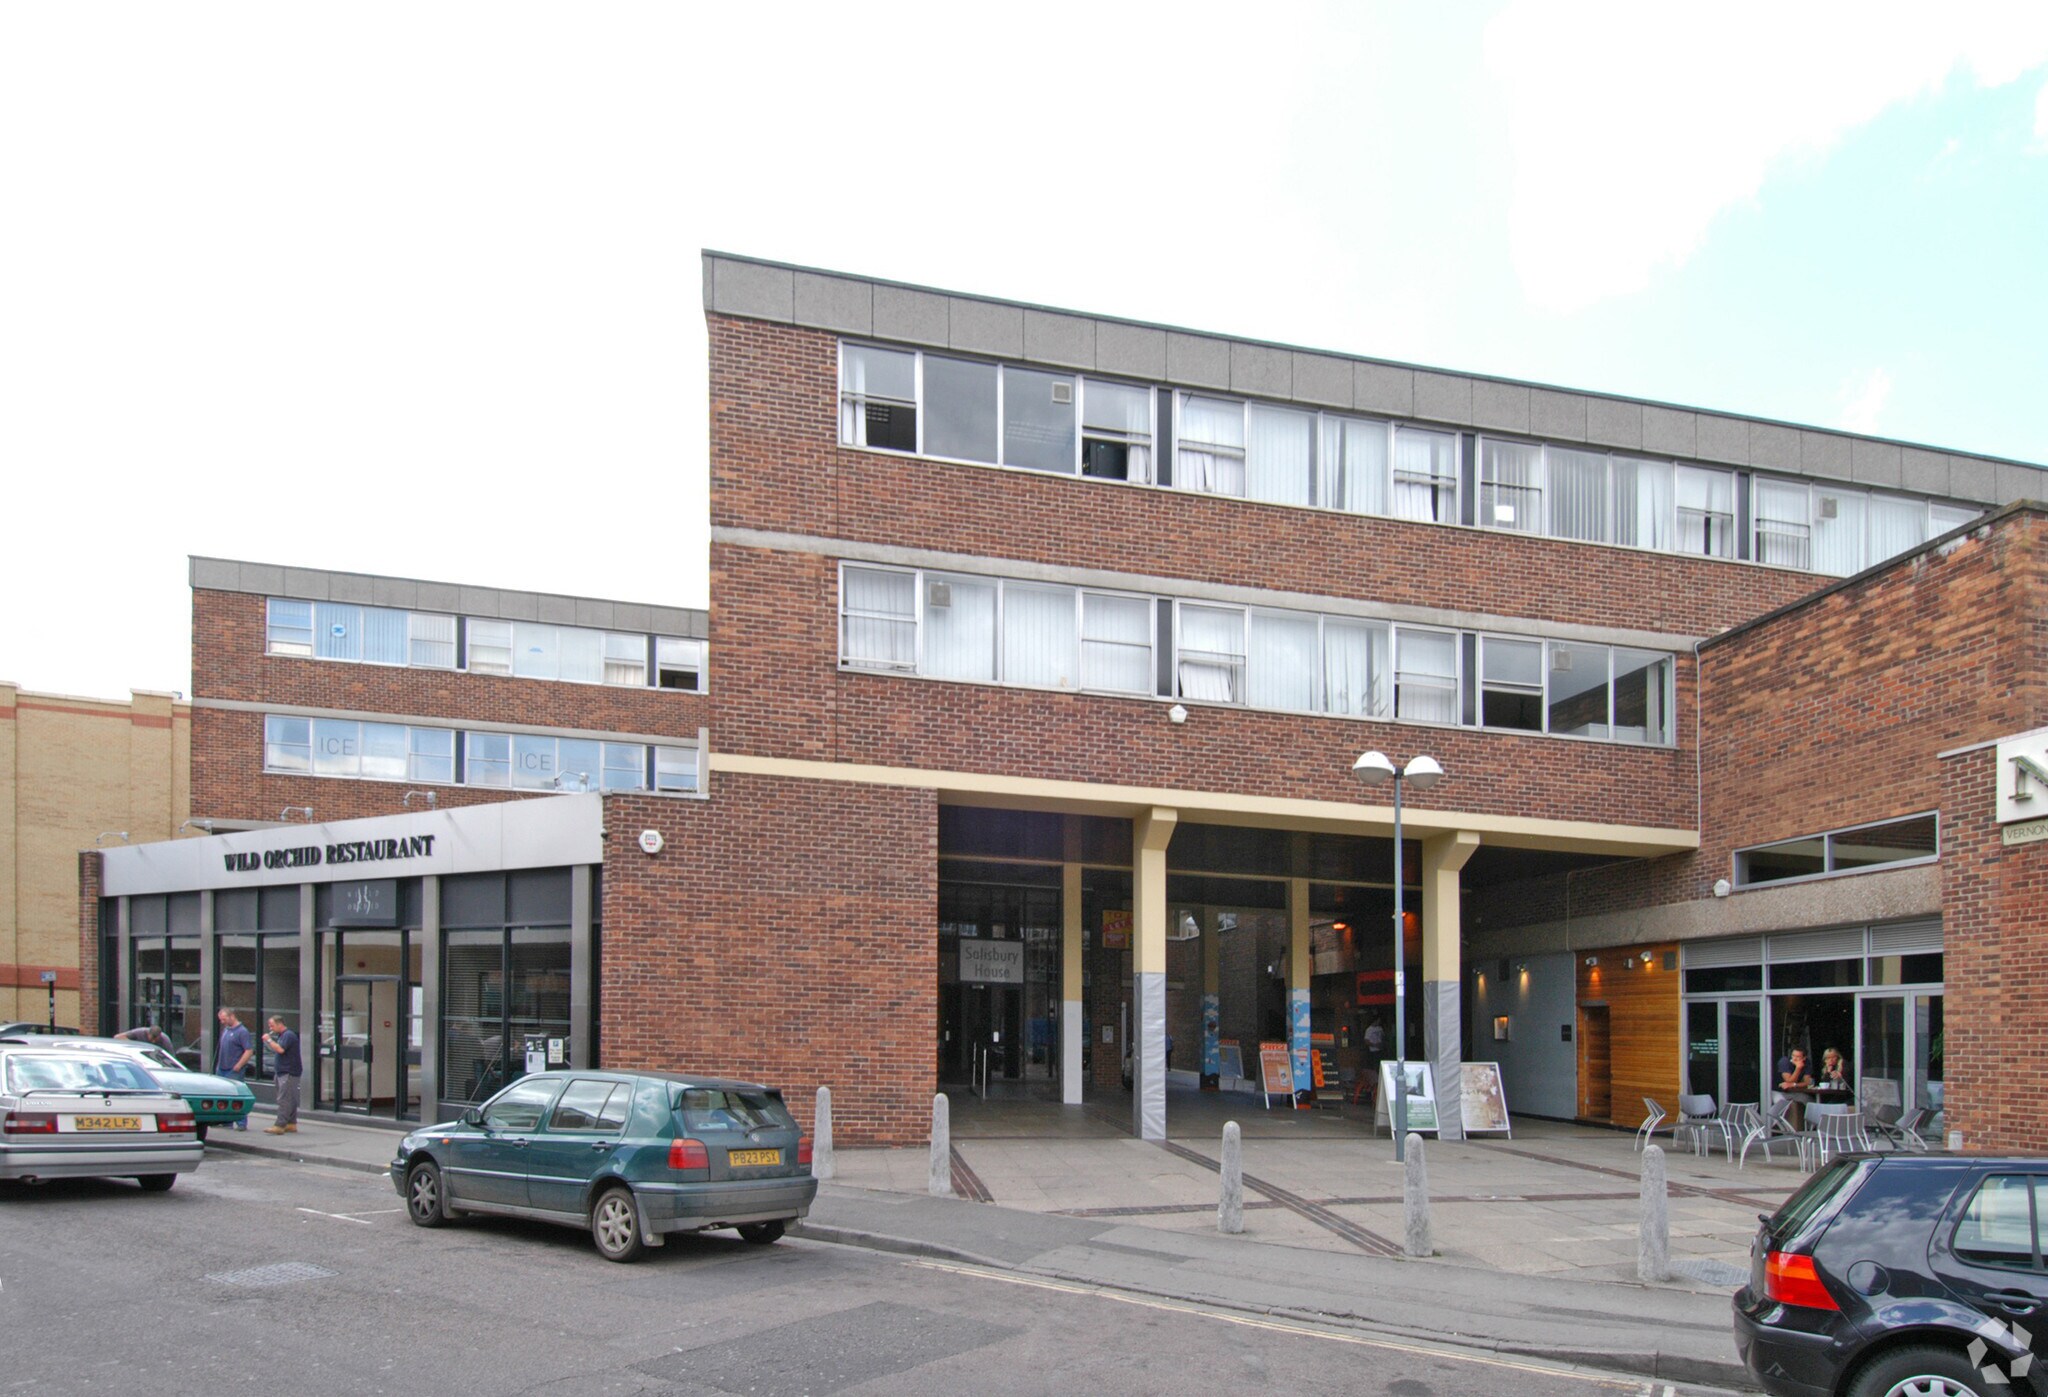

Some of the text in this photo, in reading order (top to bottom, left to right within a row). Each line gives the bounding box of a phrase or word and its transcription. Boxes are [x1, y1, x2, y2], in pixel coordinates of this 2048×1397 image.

[320, 736, 355, 756] ICE
[519, 752, 552, 771] ICE
[224, 835, 435, 871] WILD ORCHID RESTAURANT
[965, 946, 1019, 964] Salisbury
[974, 963, 1010, 978] House
[76, 1117, 140, 1128] M342 LFX
[760, 1151, 777, 1163] PSX
